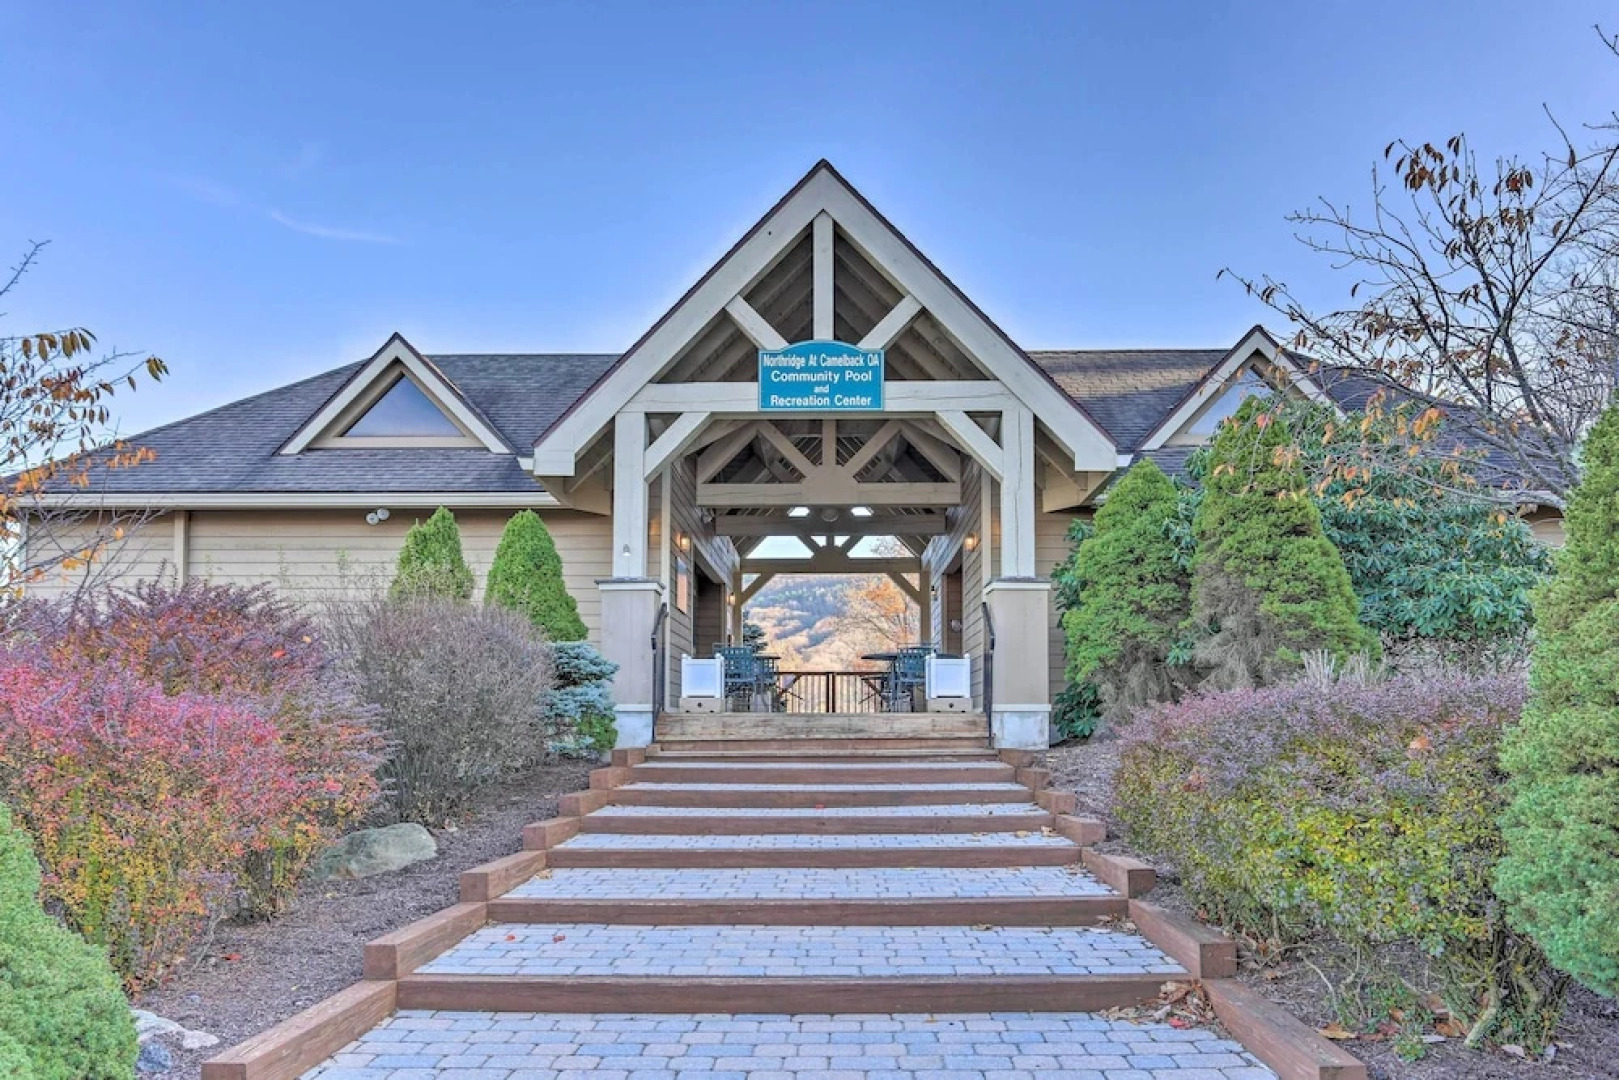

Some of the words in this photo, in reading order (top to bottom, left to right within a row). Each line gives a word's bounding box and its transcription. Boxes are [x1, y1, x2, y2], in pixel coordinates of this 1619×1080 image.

[763, 354, 805, 369] Northridge
[808, 354, 817, 366] At
[820, 353, 864, 366] Camelback
[771, 370, 839, 383] Community
[845, 370, 872, 381] Pool
[814, 384, 829, 392] and
[770, 395, 829, 406] Recreation
[834, 395, 871, 405] Center
